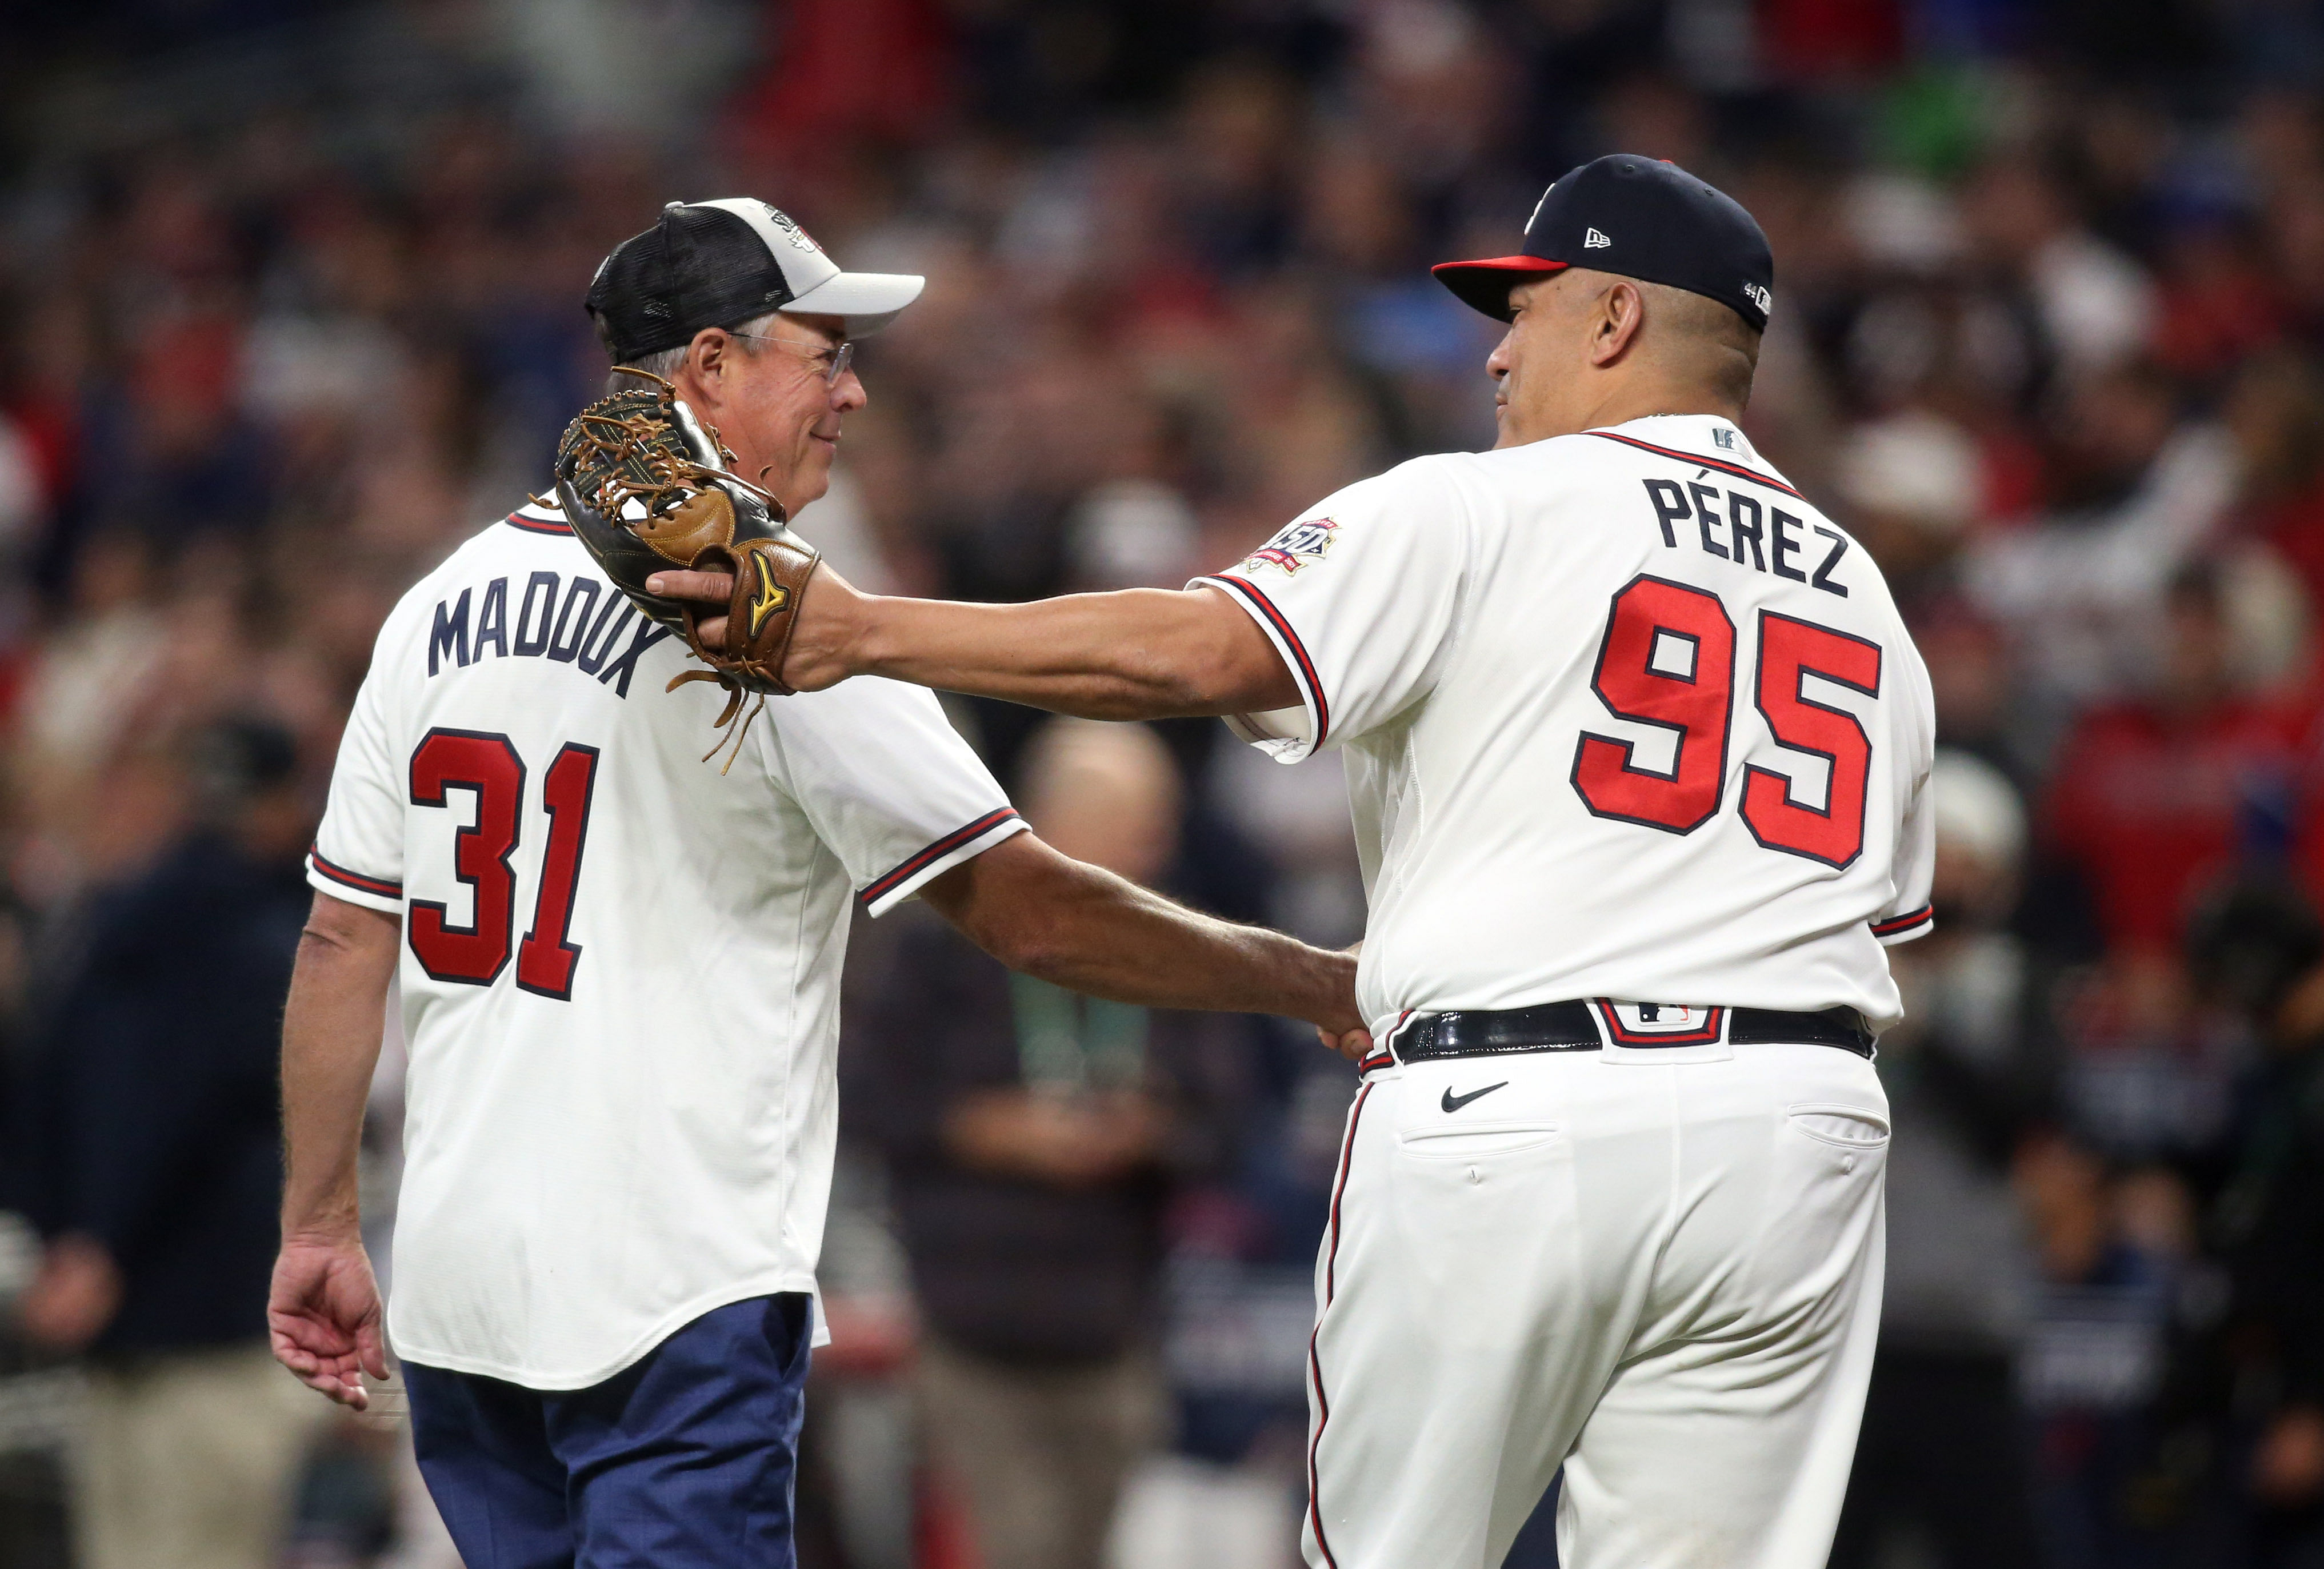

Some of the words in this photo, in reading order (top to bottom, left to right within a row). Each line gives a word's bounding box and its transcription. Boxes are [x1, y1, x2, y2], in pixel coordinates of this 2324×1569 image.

[1745, 282, 1756, 298] 44
[1642, 469, 1848, 598] PÉREZ
[429, 571, 673, 700] MADDUX
[1569, 573, 1882, 871] 95
[409, 726, 601, 1002] 31
